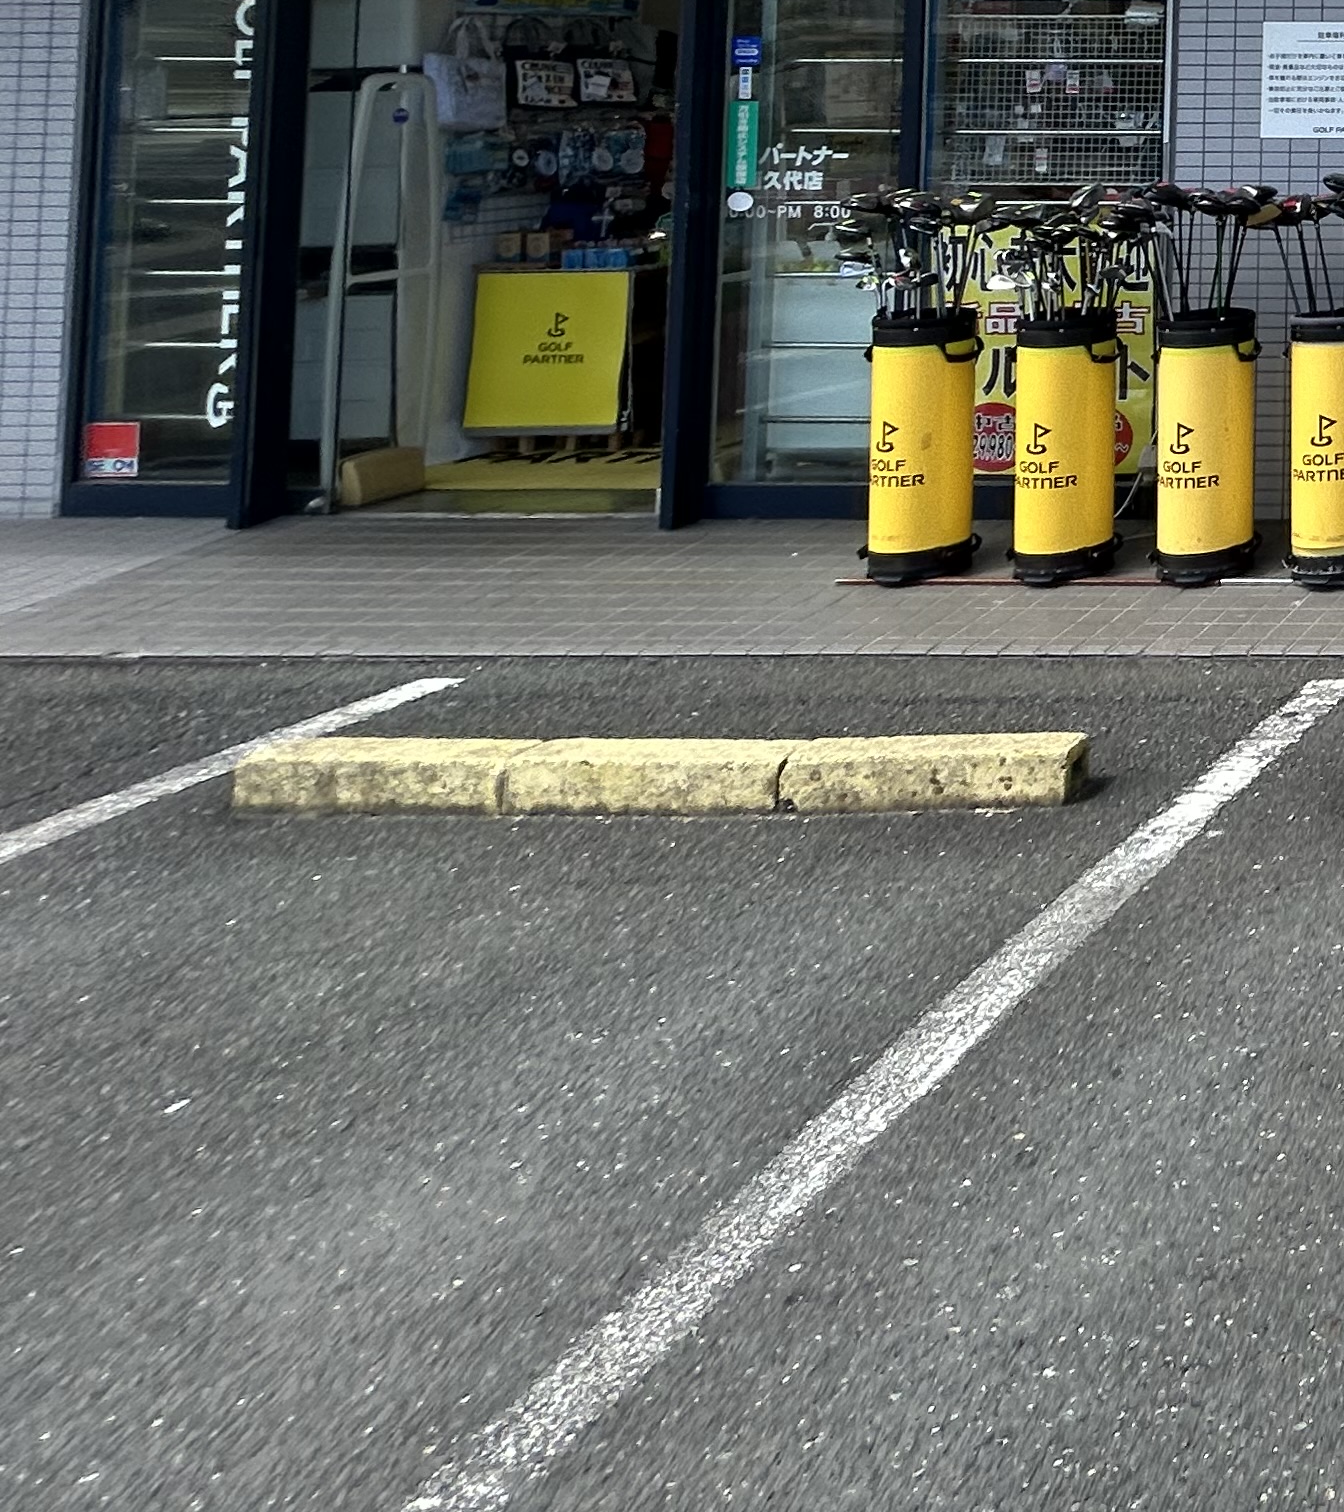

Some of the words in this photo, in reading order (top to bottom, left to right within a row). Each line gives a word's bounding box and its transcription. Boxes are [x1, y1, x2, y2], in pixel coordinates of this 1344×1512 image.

[756, 170, 825, 191] 久代店
[537, 341, 574, 353] GOLF
[522, 353, 585, 366] PARTNER
[1302, 452, 1344, 467] GOLF
[1019, 460, 1061, 474] GOLF
[1162, 460, 1202, 474] GOLF
[870, 474, 926, 488] RTNER
[1015, 474, 1078, 490] ARTNER
[1157, 474, 1220, 490] ARTNER
